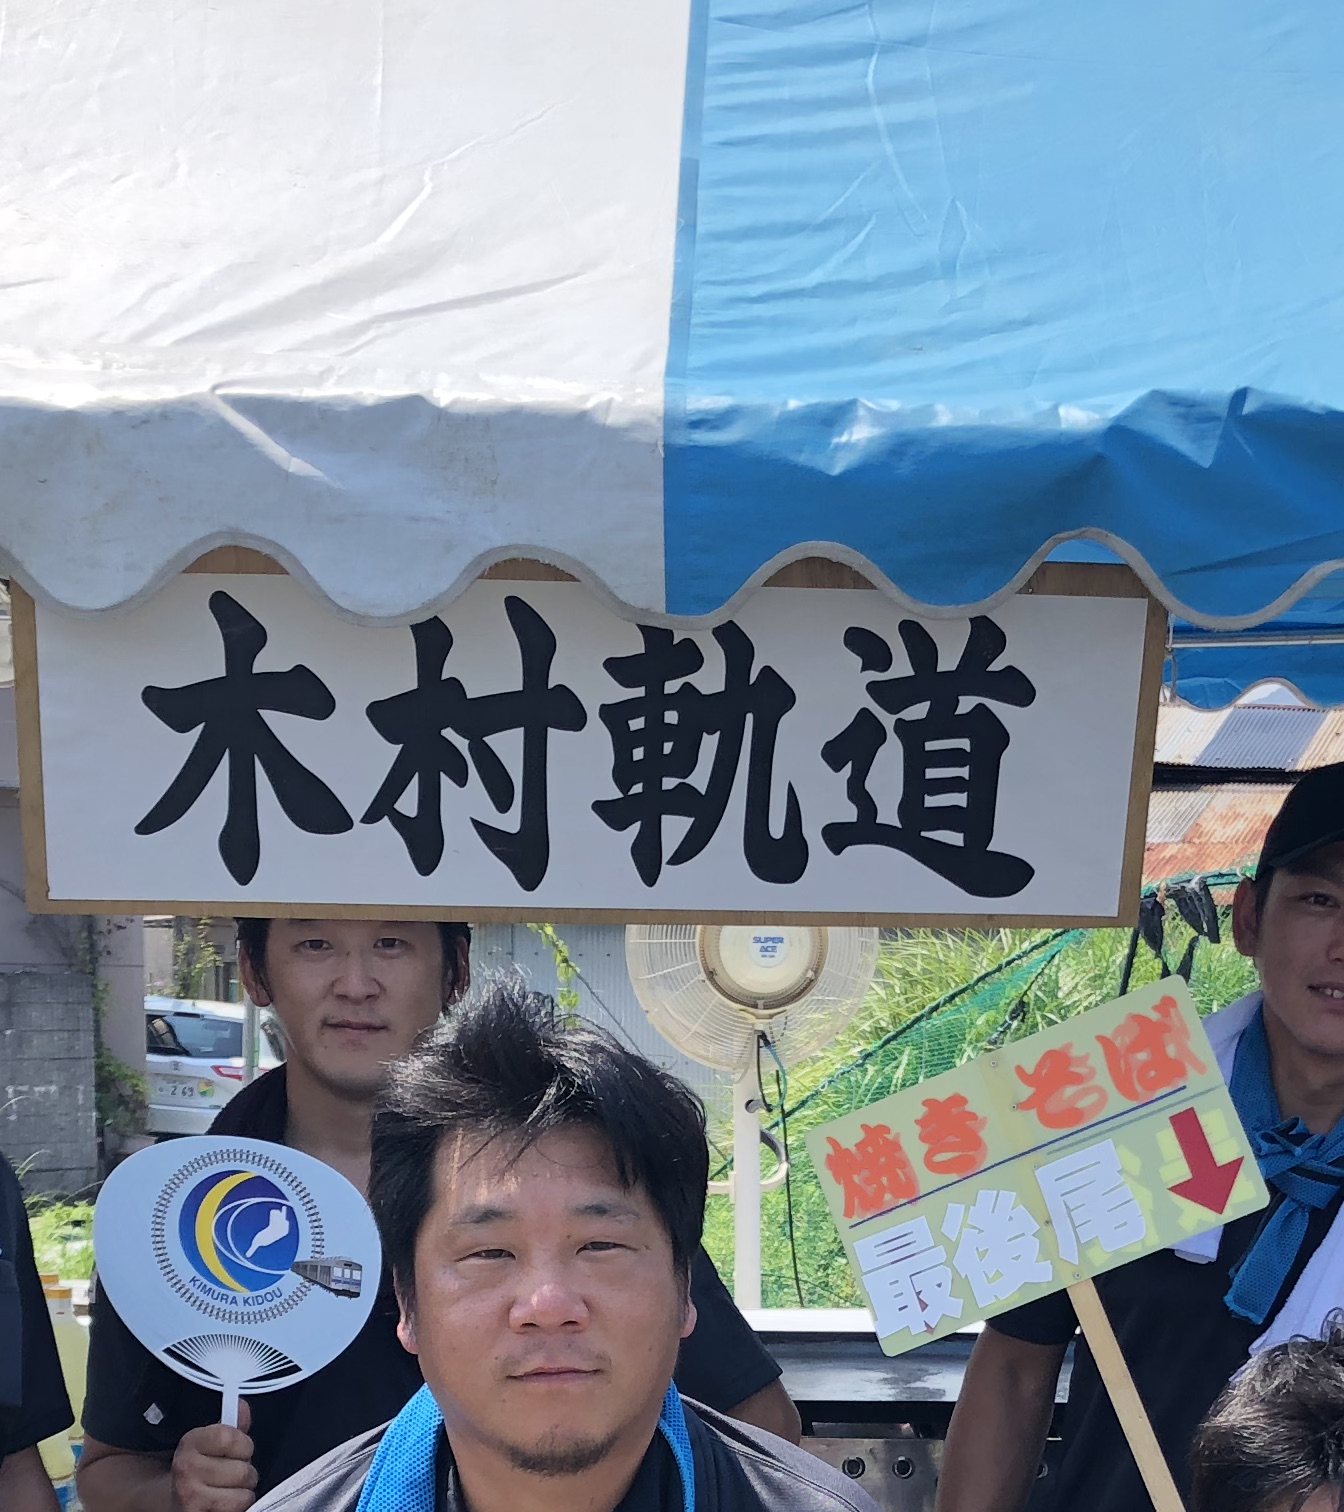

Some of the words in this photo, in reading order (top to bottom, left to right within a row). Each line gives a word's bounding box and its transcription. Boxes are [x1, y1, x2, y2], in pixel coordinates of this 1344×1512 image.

[136, 589, 1037, 897] 木村軌道
[752, 936, 785, 944] SUPER
[759, 945, 778, 953] ACE
[851, 1138, 1147, 1341] 最後尾
[189, 1275, 239, 1307] KIMURA
[242, 1286, 284, 1307] KIDOU
